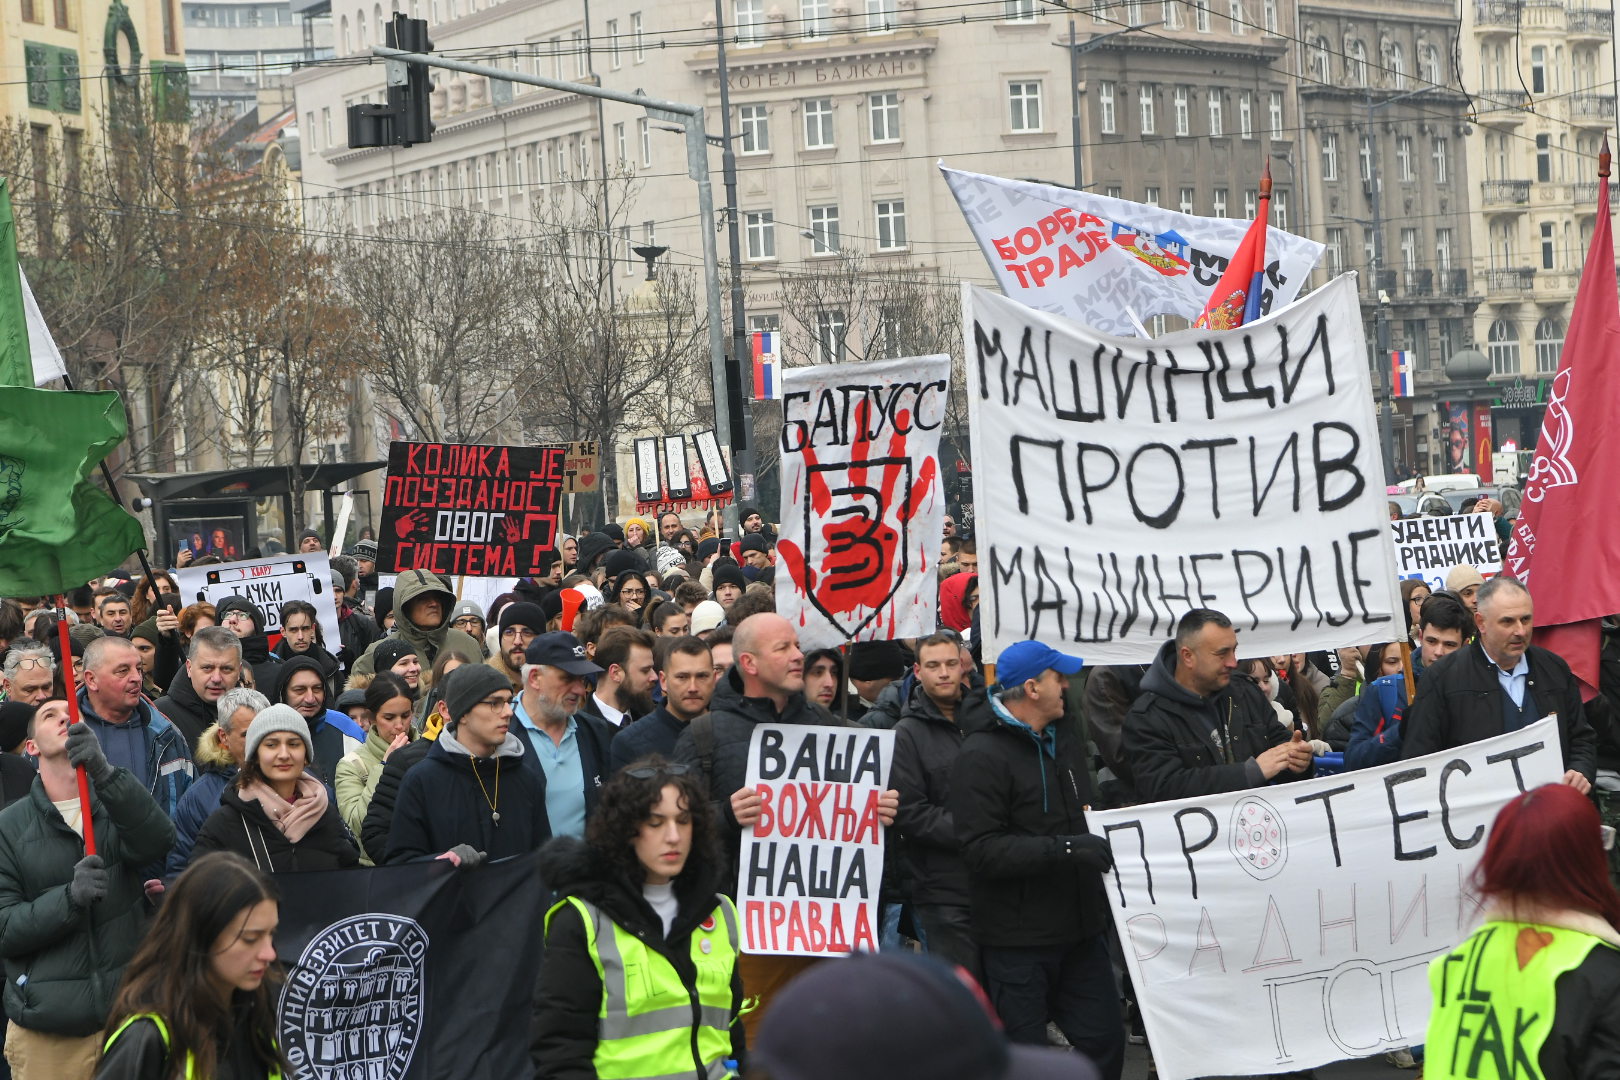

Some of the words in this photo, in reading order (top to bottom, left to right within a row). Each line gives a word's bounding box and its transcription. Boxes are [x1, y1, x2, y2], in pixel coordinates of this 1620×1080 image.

[727, 70, 796, 89] ХОТЕЛ
[815, 61, 903, 83] БАЛКАН
[991, 207, 1105, 261] БОРБА
[1005, 230, 1112, 289] ТРАЈЕ
[974, 313, 1335, 424] МАШИНЦИ
[782, 380, 946, 453] БАПУСС
[406, 443, 511, 477] КОЛИКА
[530, 449, 565, 479] ЈЕ
[1010, 421, 1366, 529] ПРОТИВ
[384, 476, 562, 511] ПОУЗДАНОСТ
[434, 511, 505, 542] ОВОГ
[1391, 515, 1486, 544] УДЕНТИ
[251, 565, 272, 577] КВАРУ
[394, 542, 516, 576] СИСТЕМА
[1400, 540, 1500, 571] РАДНИКЕ
[990, 529, 1392, 643] МАШИНЕРИЈЕ
[759, 729, 881, 786] ВАША
[753, 782, 879, 845] ВОЖЊА
[747, 842, 869, 899] НАША
[745, 900, 877, 953] ПРАВДА
[1125, 863, 1486, 986] РАДНИК
[284, 921, 380, 1034] УНИВЕРЗИТЕТ
[388, 923, 402, 940] У
[1450, 1003, 1541, 1080] FAK
